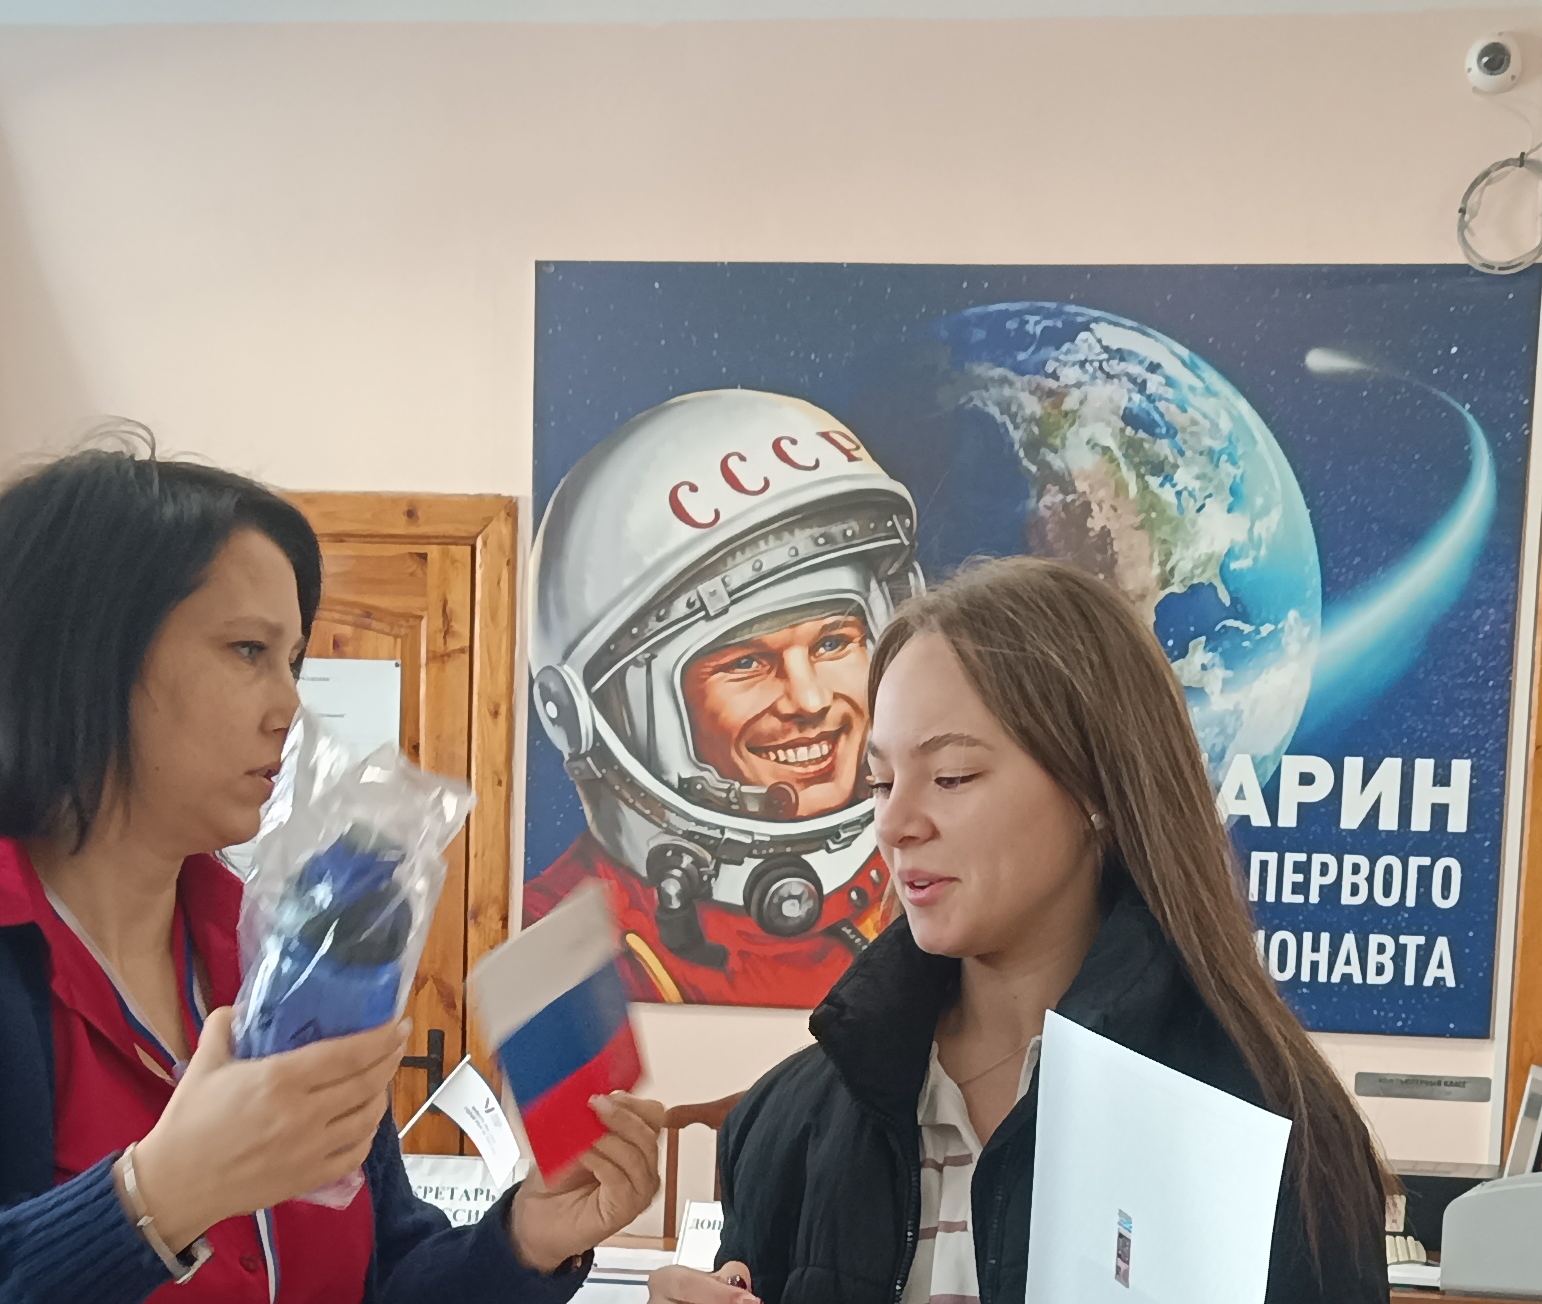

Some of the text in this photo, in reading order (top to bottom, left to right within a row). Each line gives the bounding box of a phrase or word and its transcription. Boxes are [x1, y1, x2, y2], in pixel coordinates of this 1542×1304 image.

[668, 429, 864, 530] СССР
[1207, 753, 1472, 833] АРИН
[1248, 851, 1463, 909] ПЕРВОГО
